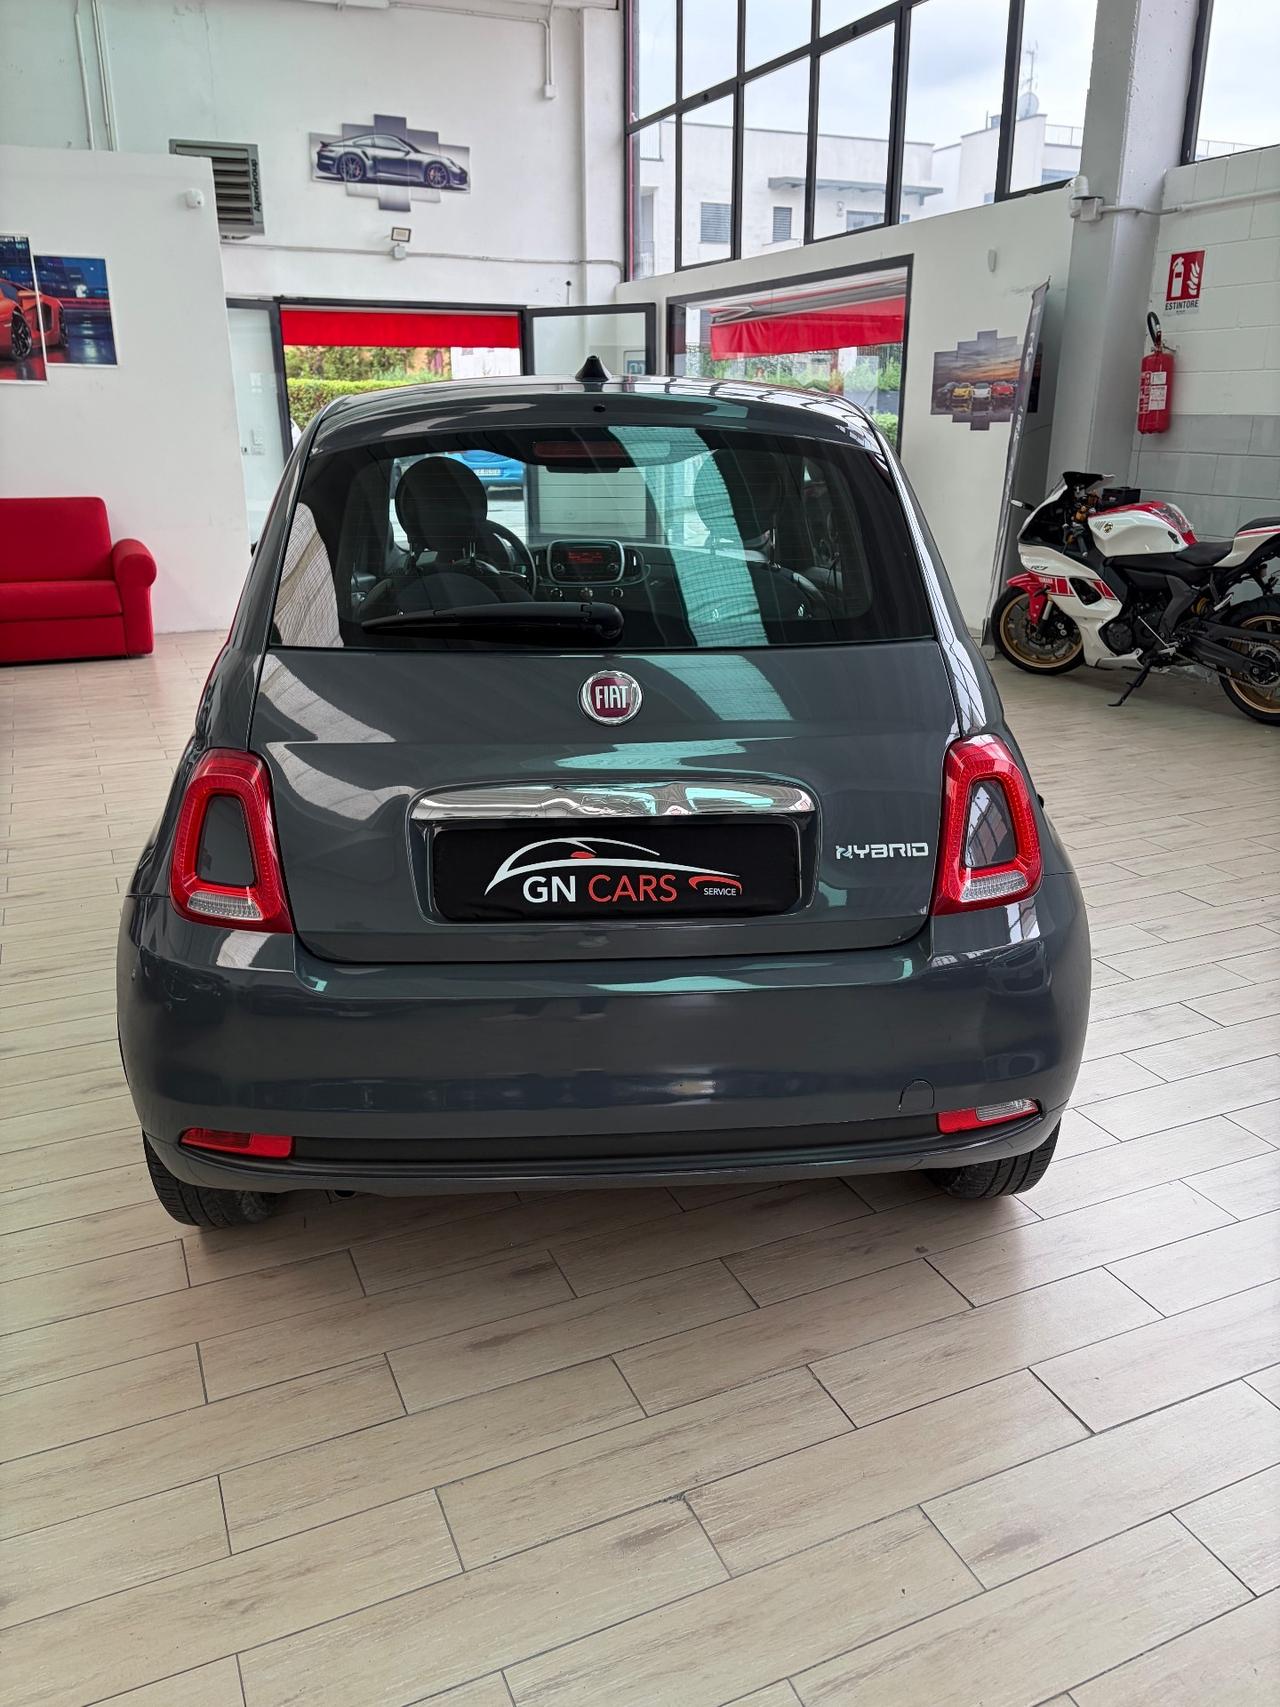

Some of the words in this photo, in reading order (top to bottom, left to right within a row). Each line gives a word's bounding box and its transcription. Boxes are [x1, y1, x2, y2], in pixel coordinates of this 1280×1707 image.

[1165, 300, 1199, 310] ESTINTORE
[595, 685, 628, 709] FIAT
[835, 842, 929, 859] HYBRID
[522, 875, 576, 902] GN
[588, 874, 678, 902] CARS
[703, 887, 737, 897] SERVICE
